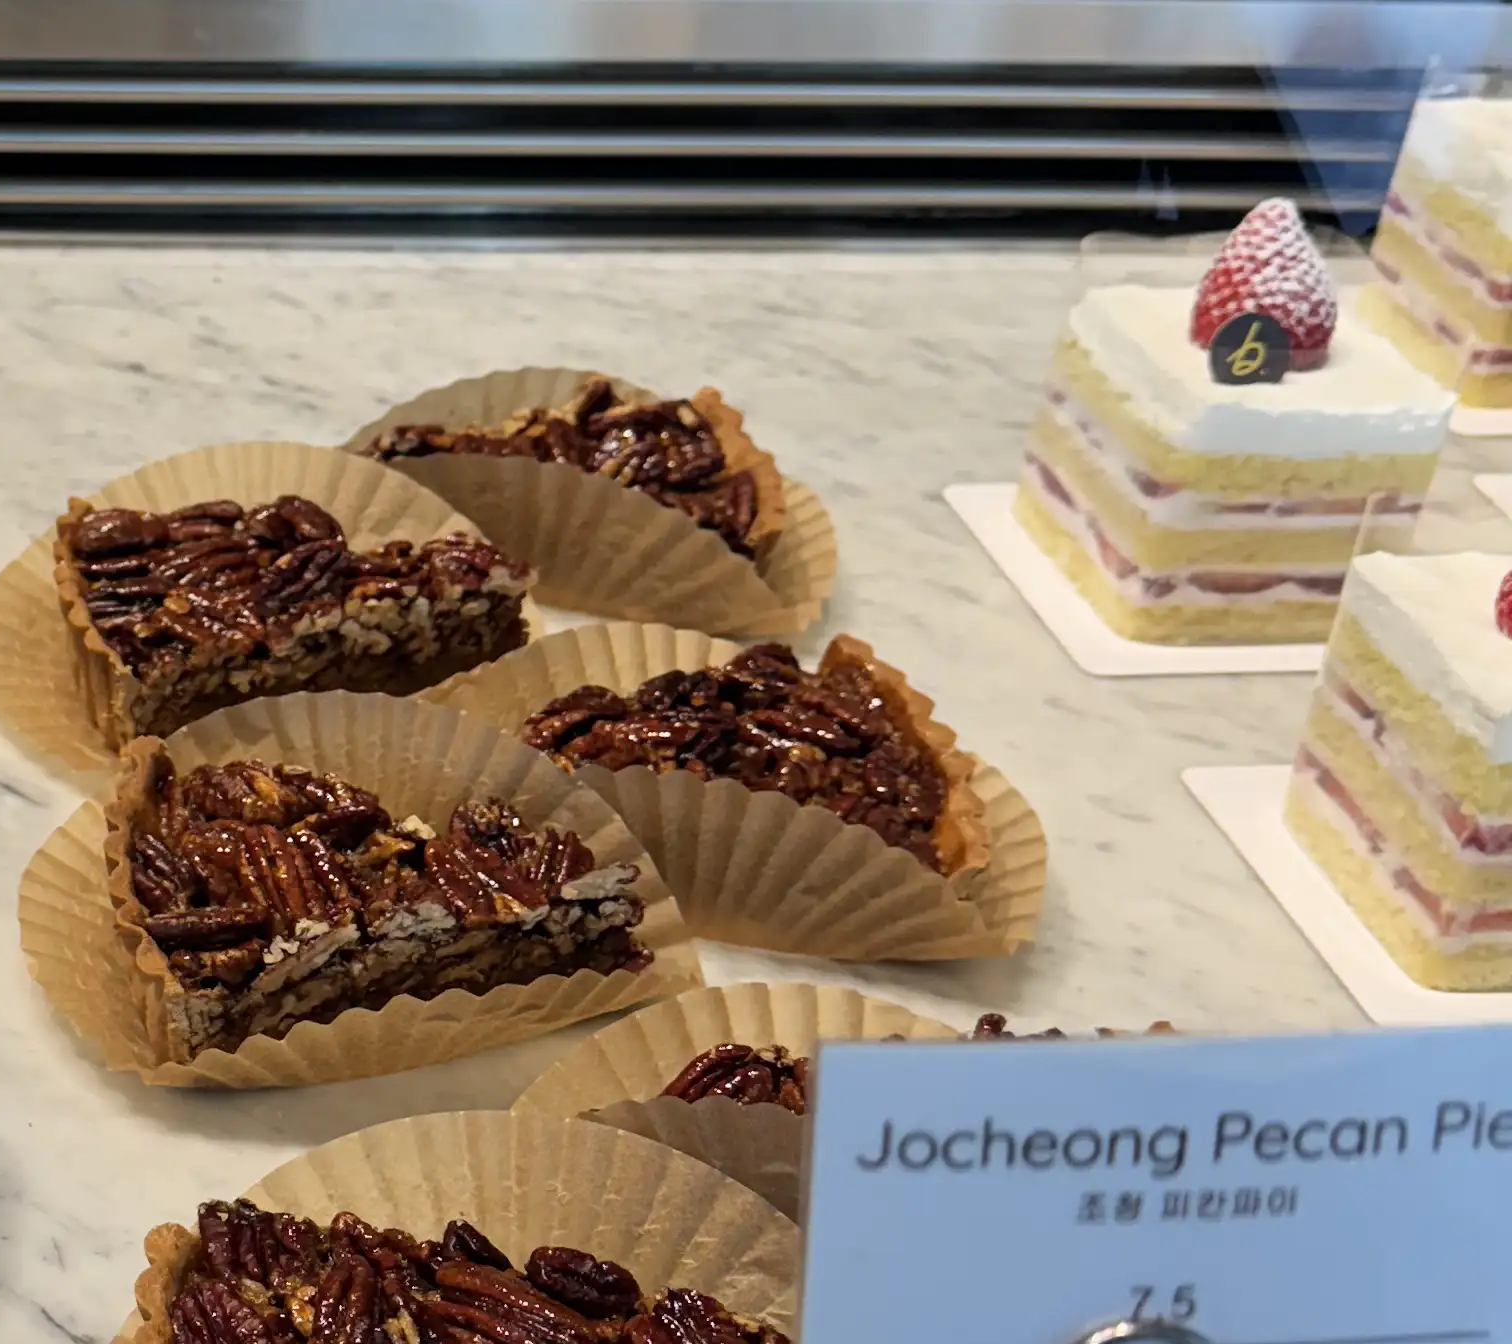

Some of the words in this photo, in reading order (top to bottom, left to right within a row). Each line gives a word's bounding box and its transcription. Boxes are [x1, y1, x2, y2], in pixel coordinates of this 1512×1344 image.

[856, 1116, 1188, 1179] Jocheong
[1212, 1110, 1409, 1165] Pecan
[1431, 1099, 1512, 1154] Pie
[1161, 1185, 1299, 1223] 피칸파이
